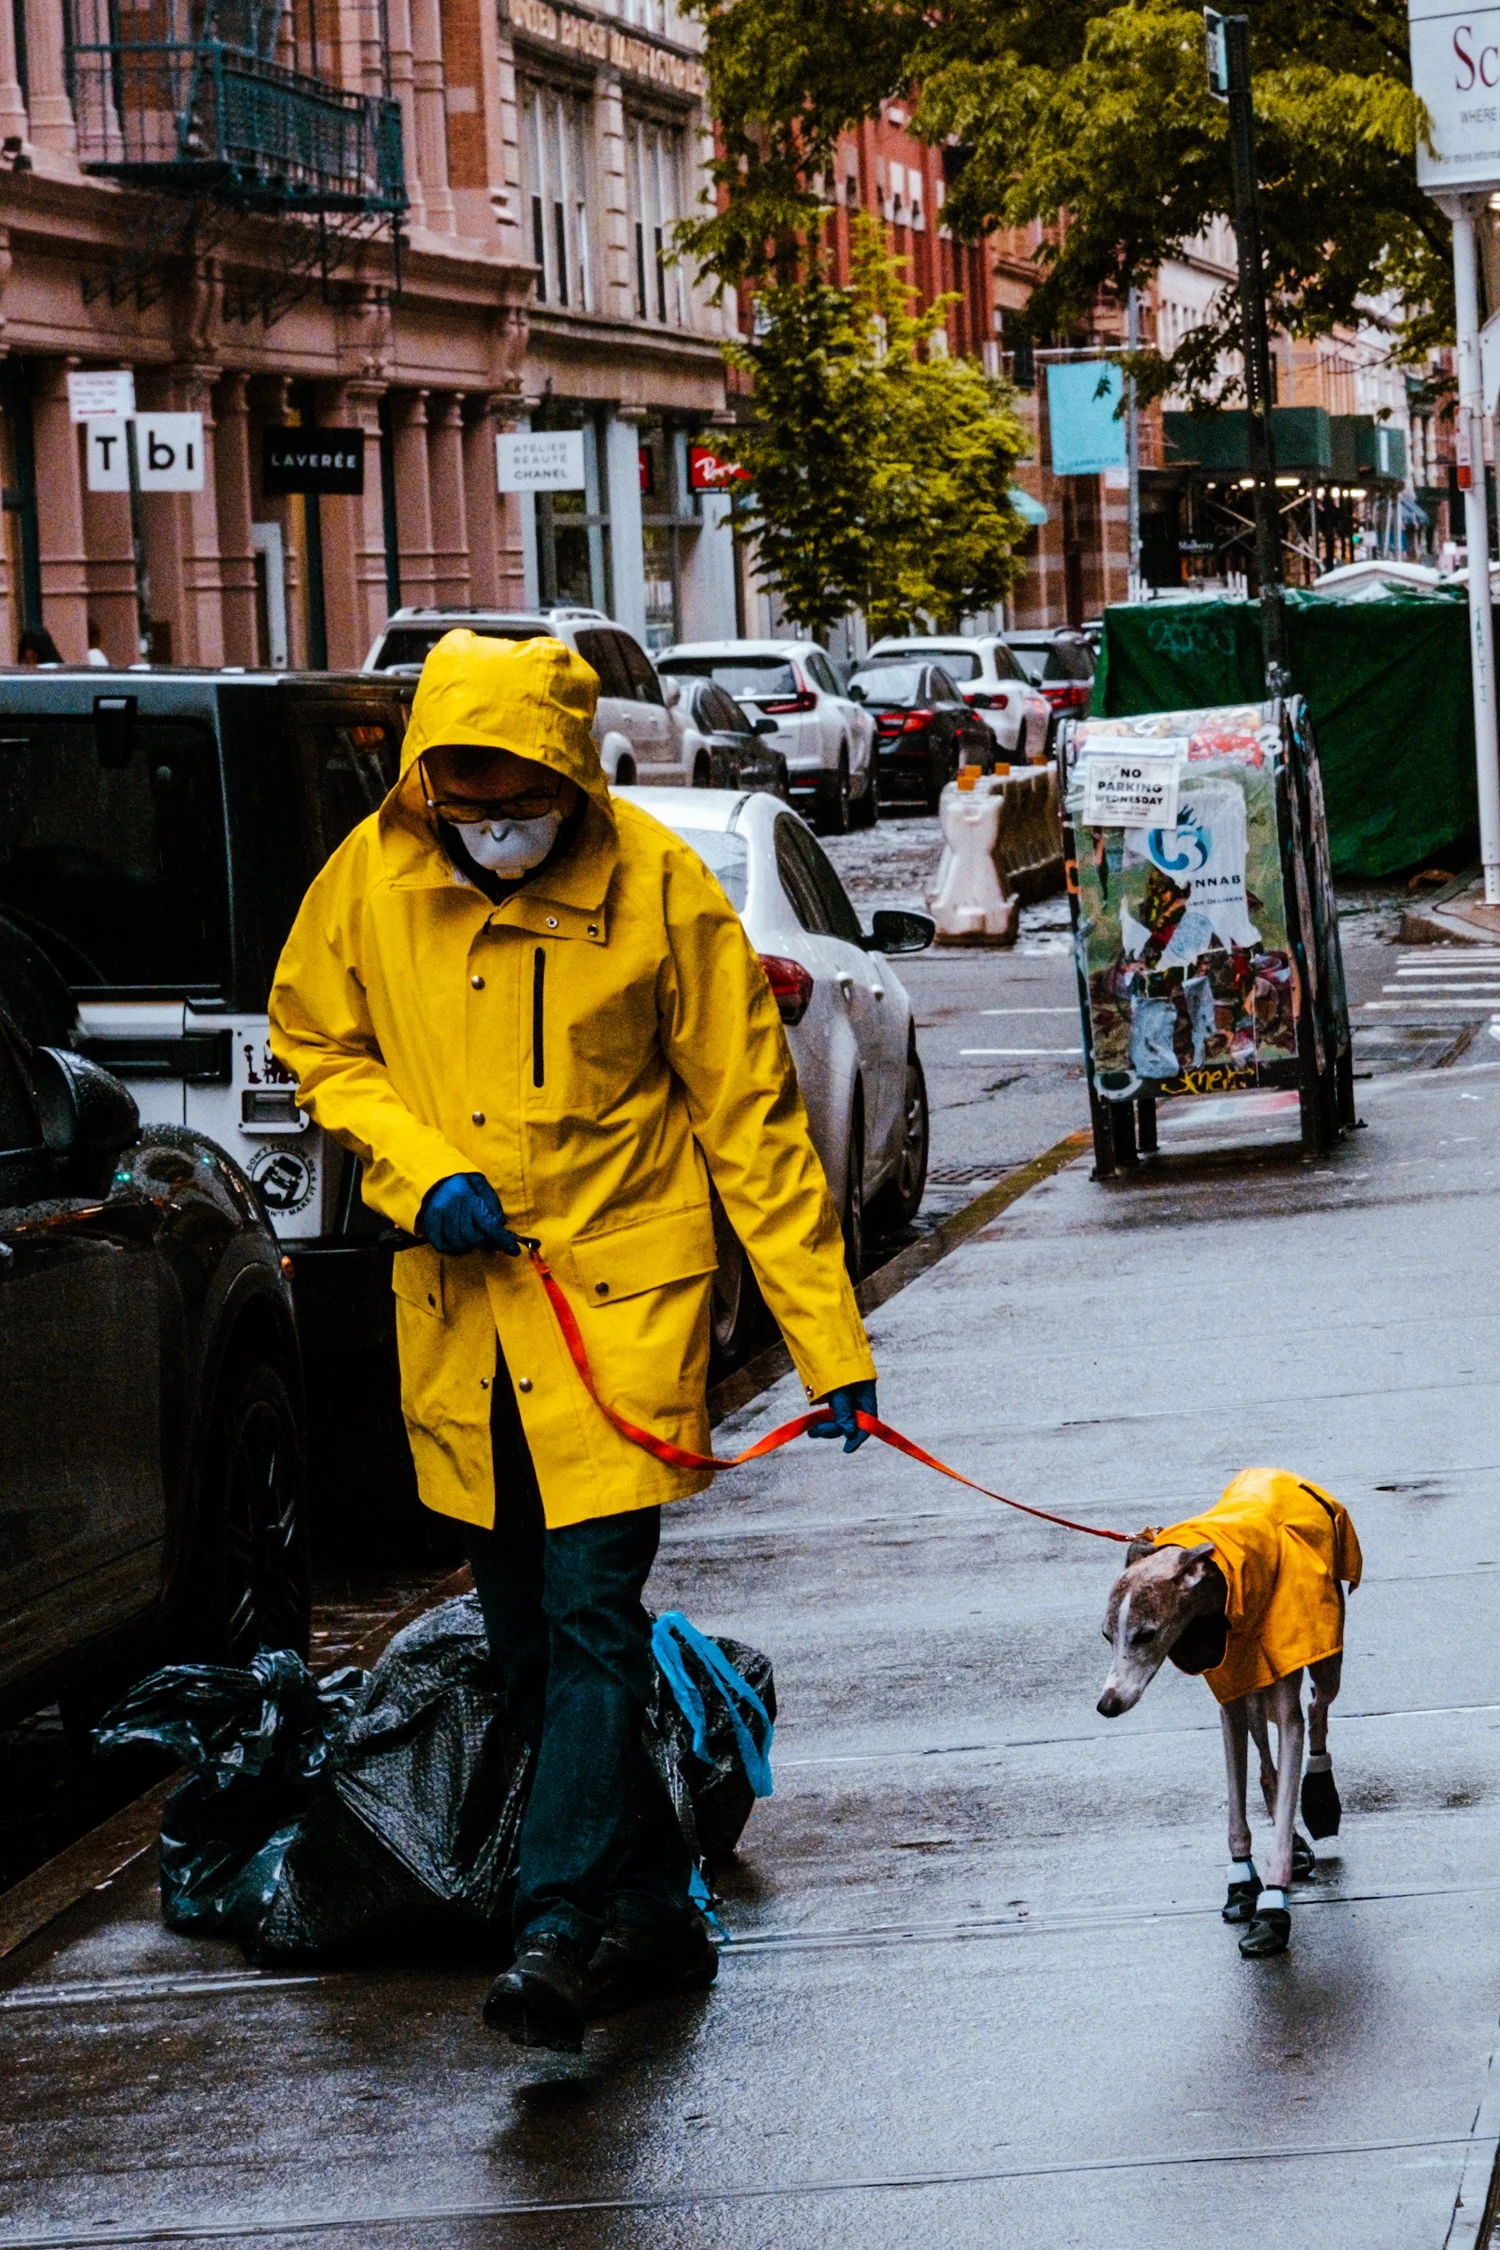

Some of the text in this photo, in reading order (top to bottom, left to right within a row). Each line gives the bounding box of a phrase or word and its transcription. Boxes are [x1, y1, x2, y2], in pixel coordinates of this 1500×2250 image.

[1460, 106, 1497, 124] WHERE
[514, 469, 568, 480] CHANEL
[1120, 768, 1142, 779] NO
[1098, 781, 1163, 793] PARKING
[1095, 794, 1164, 806] WEDNESDAY
